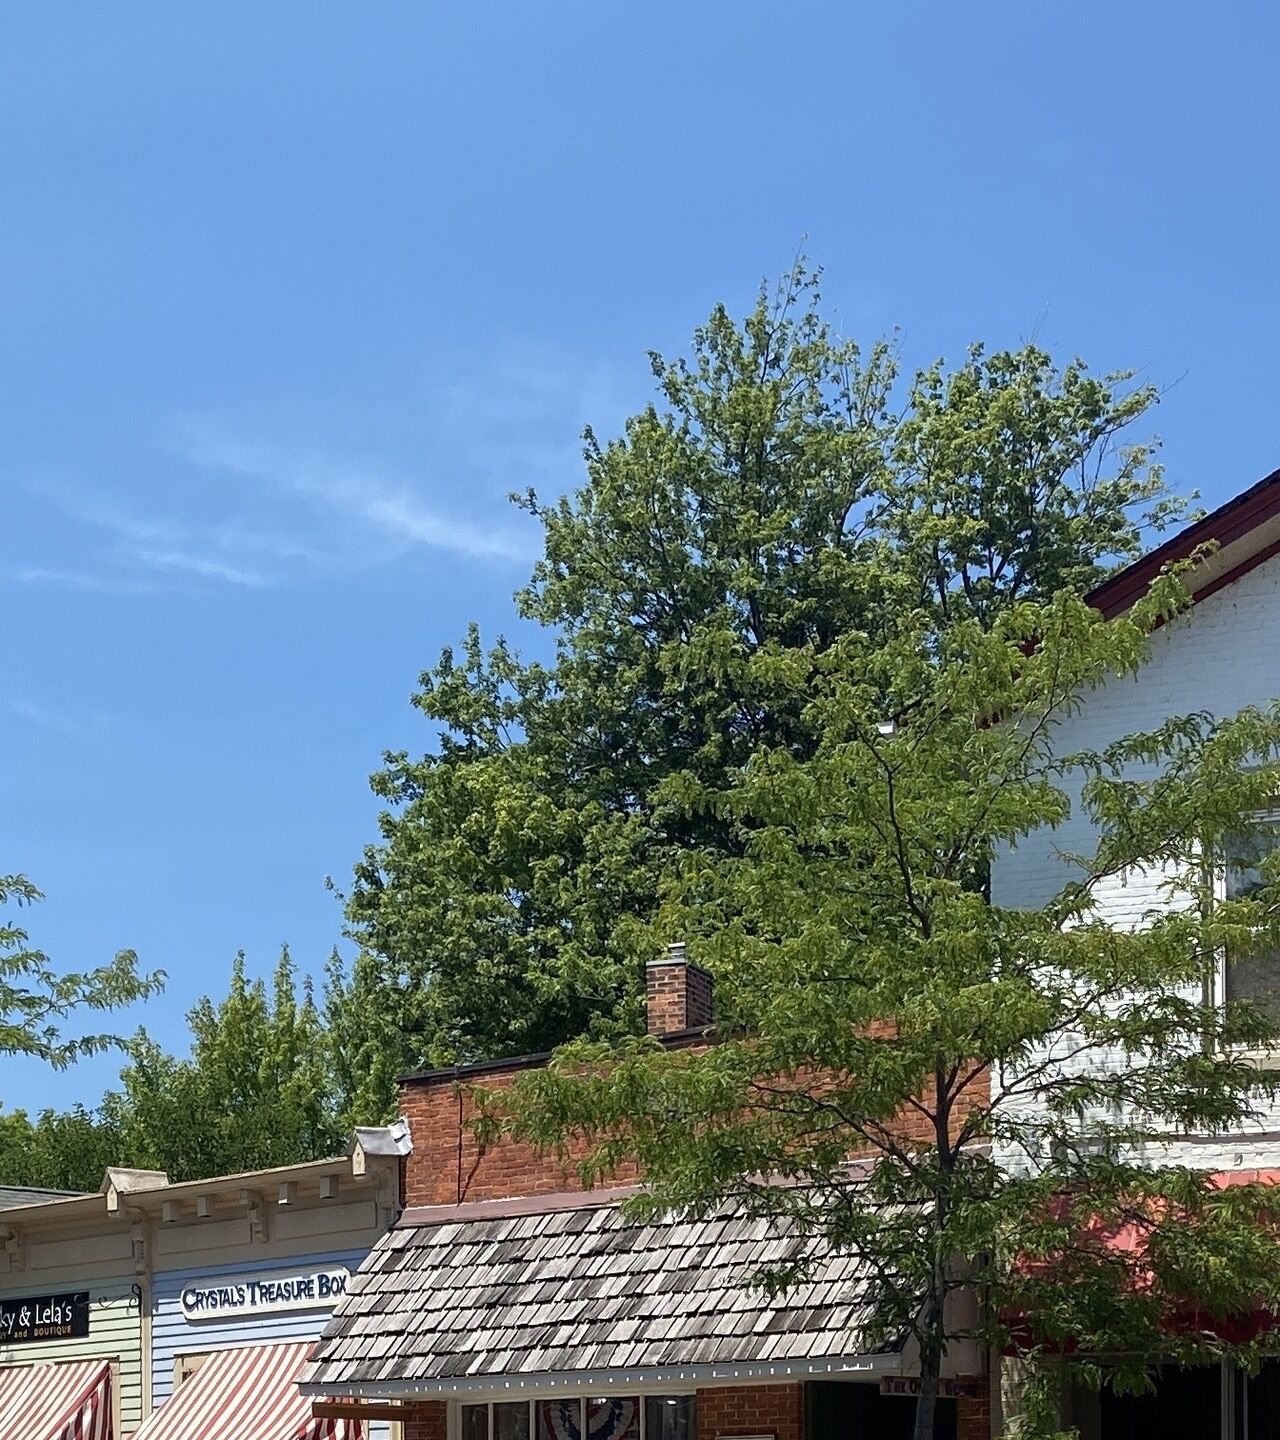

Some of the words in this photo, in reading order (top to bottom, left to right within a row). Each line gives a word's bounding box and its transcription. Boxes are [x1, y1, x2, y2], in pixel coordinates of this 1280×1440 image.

[19, 1306, 31, 1327] &
[35, 1298, 72, 1325] Lela's
[13, 1329, 28, 1338] and
[34, 1325, 72, 1337] BOUTIQUE
